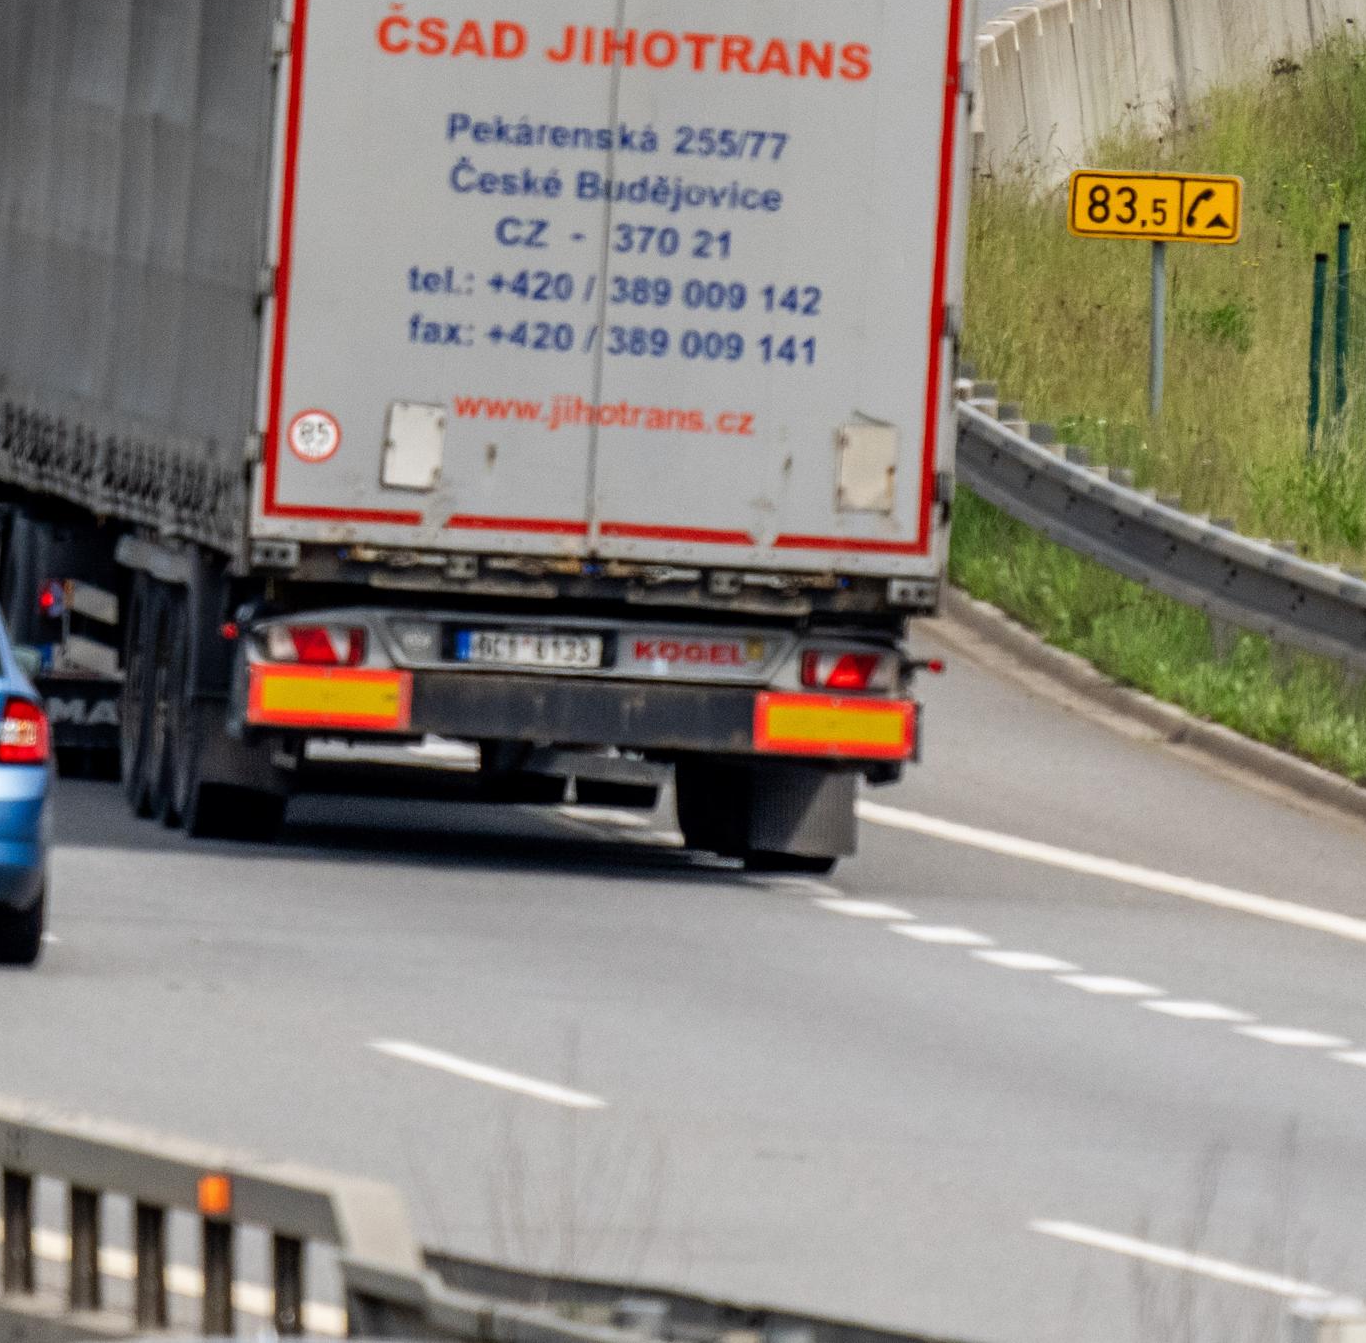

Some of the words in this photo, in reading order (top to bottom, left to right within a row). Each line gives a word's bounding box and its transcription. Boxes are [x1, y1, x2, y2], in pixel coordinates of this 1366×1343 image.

[376, 3, 529, 60] ČSAD
[546, 25, 874, 82] JIHOTRANS
[445, 112, 659, 154] Pekárenská
[673, 125, 790, 162] 255/77
[449, 157, 564, 199] České
[575, 170, 784, 214] Budějovice
[494, 215, 551, 249] CZ
[612, 222, 681, 258] 370
[691, 229, 733, 259] 21
[407, 266, 476, 296] tel.:
[487, 270, 575, 302] +420
[609, 275, 673, 307] 389
[681, 279, 748, 311] 009
[762, 284, 824, 317] 142
[407, 313, 476, 346] fax:
[487, 321, 575, 353] +420
[606, 325, 670, 357] 389
[678, 329, 745, 361] 009
[759, 334, 819, 365] 141
[453, 394, 757, 436] www.jihotrans.cz
